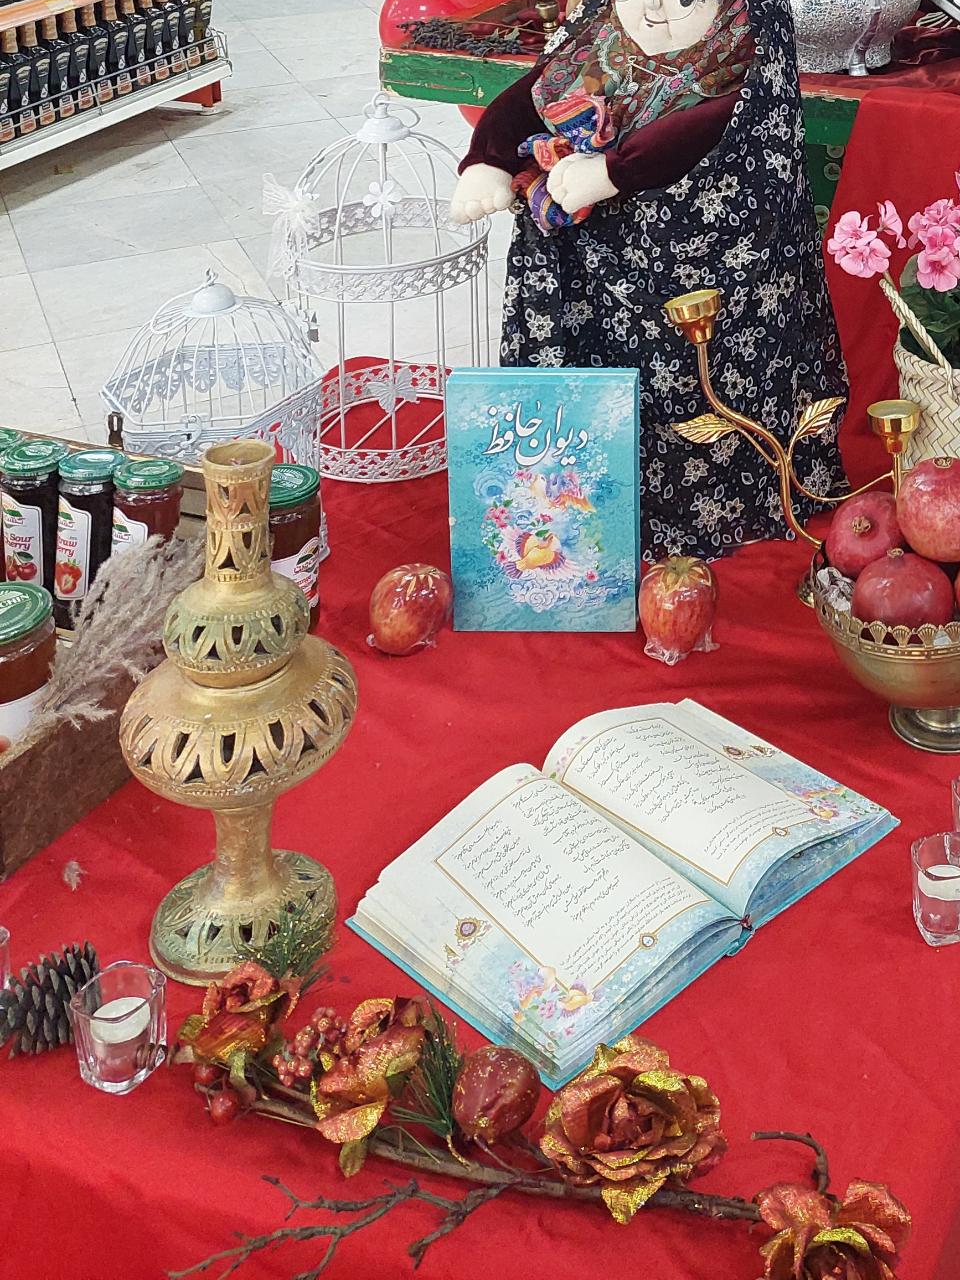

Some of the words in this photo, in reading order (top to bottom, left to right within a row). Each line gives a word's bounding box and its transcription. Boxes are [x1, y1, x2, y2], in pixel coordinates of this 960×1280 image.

[481, 400, 543, 455] حافظ
[514, 404, 589, 467] دیوان
[10, 533, 34, 544] Sour
